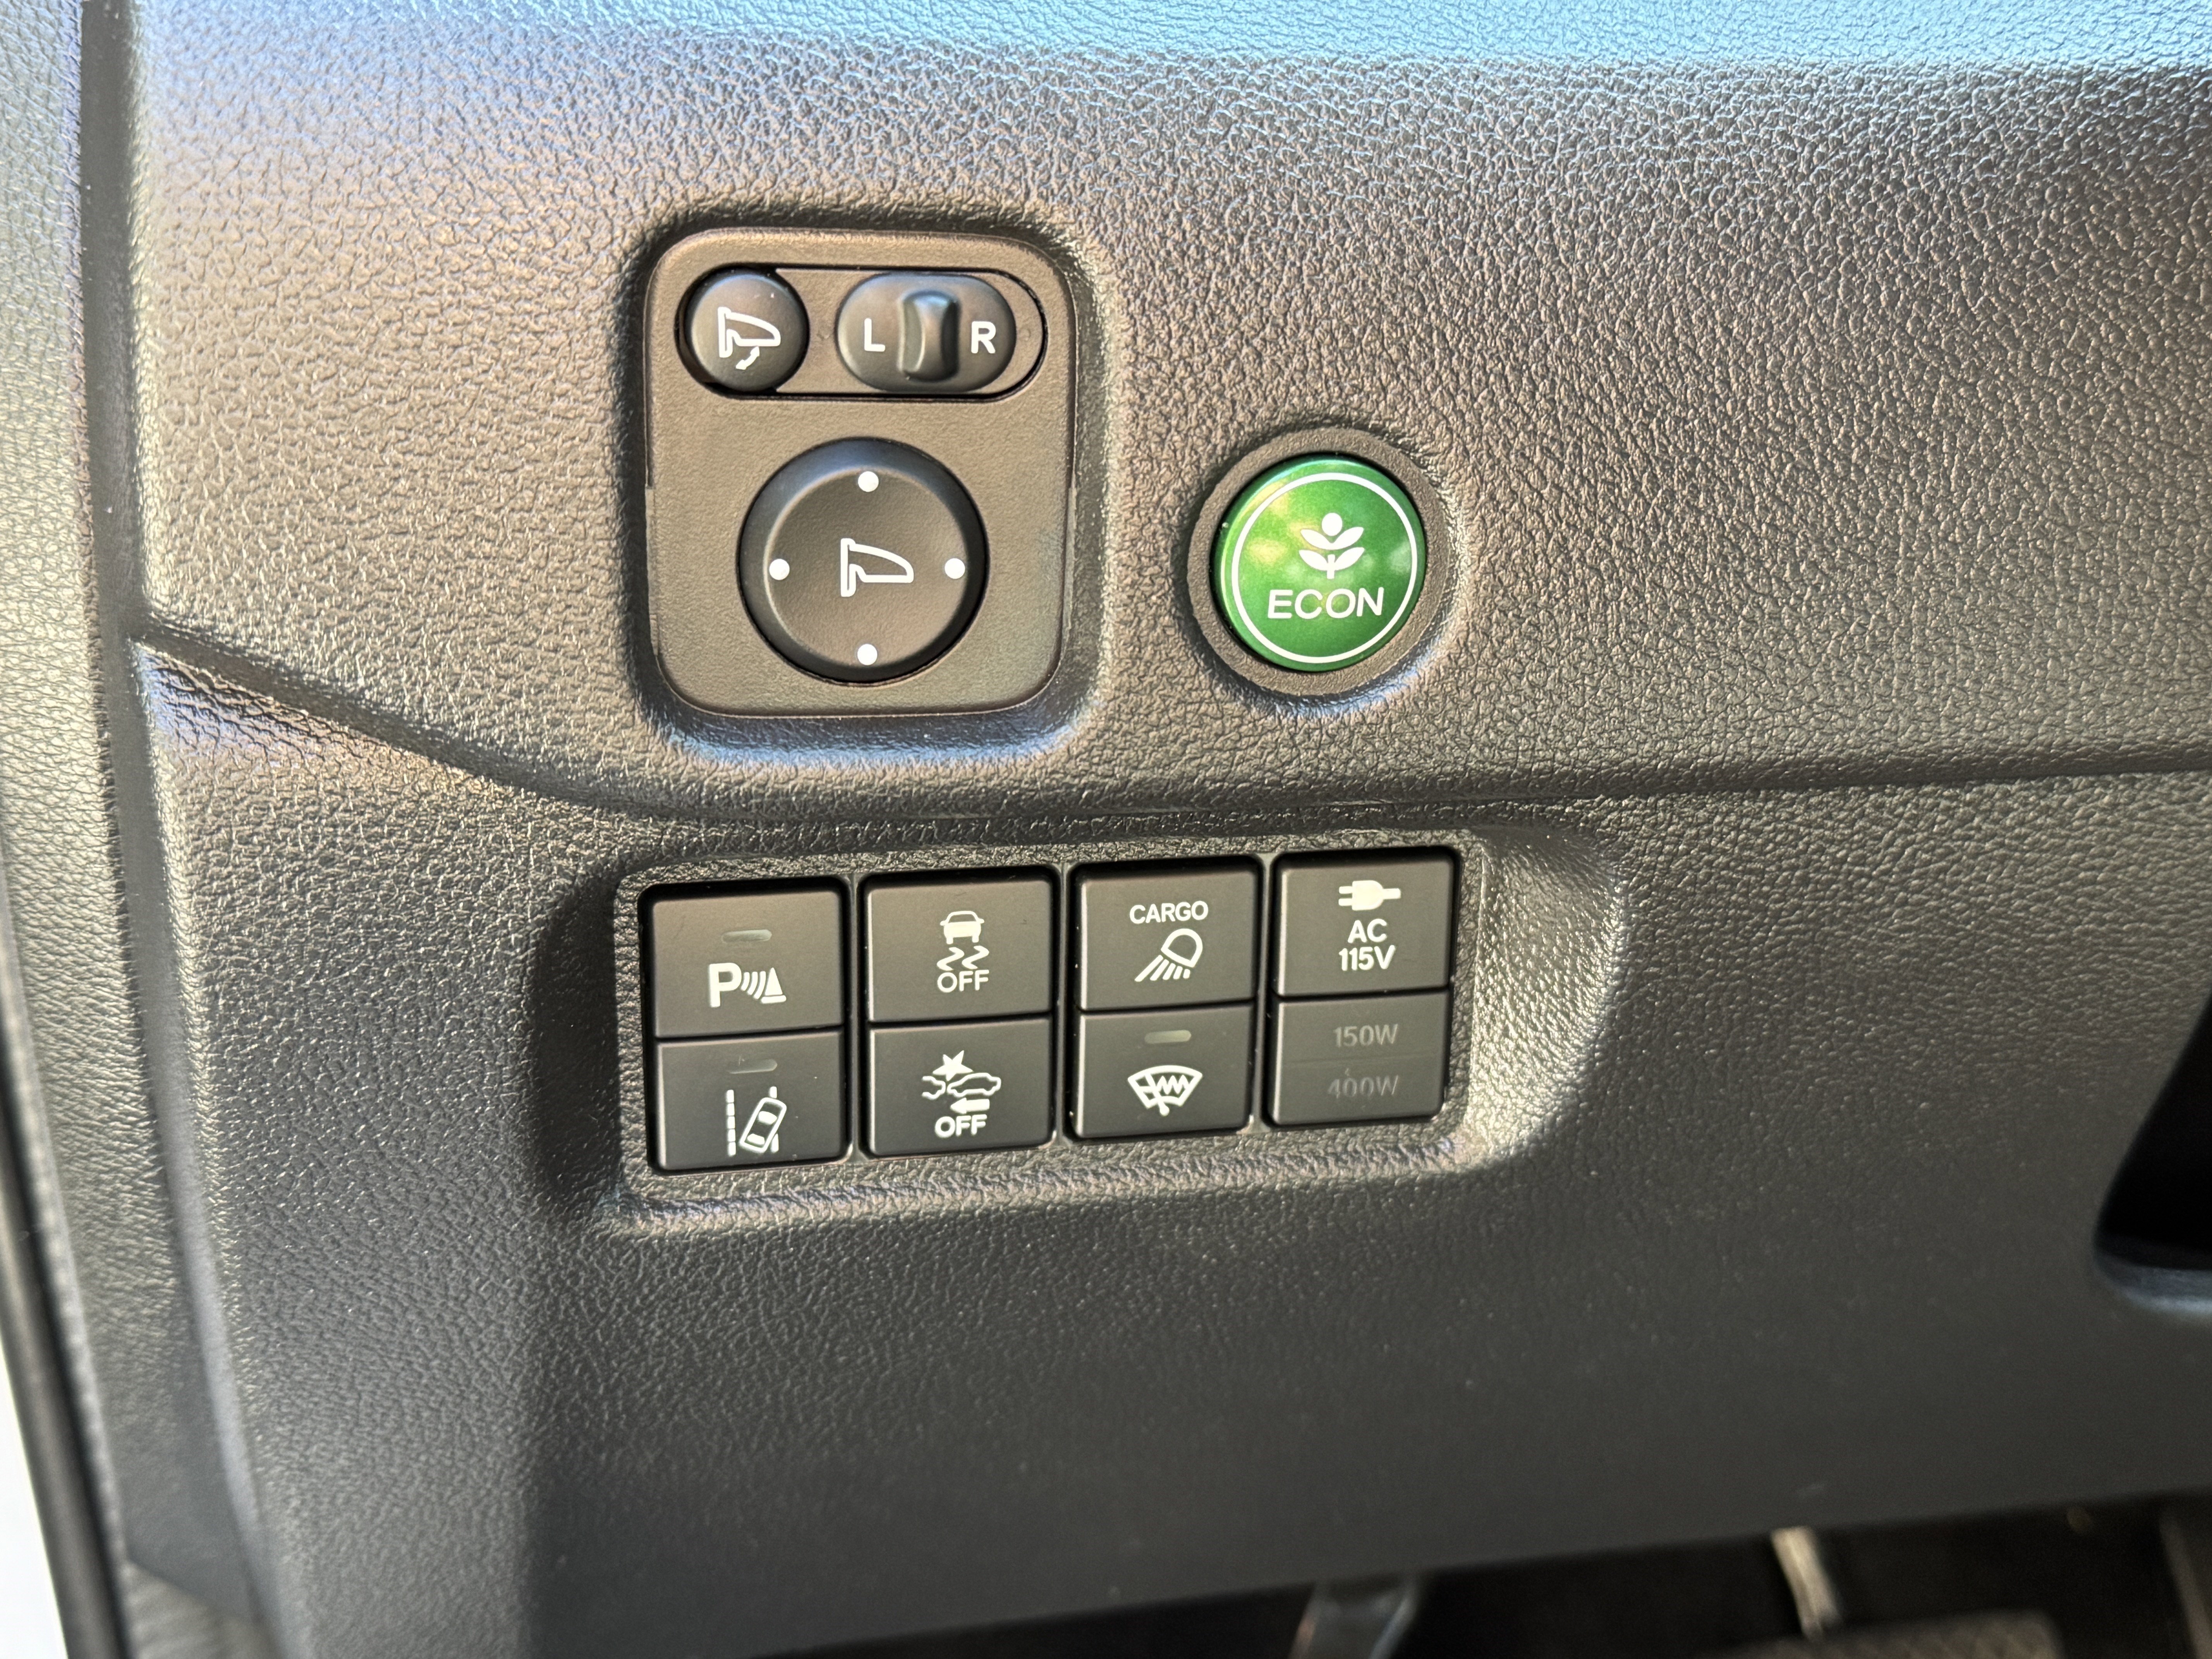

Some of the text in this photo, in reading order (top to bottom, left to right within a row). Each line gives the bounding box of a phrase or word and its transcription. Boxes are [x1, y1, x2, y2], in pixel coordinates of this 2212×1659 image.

[864, 318, 886, 352] L
[971, 321, 996, 354] R
[1267, 587, 1384, 619] ECON
[1129, 900, 1209, 924] CARGO
[1347, 918, 1388, 944] AC
[1338, 945, 1396, 971] 115V
[708, 962, 742, 1008] P
[937, 969, 989, 993] OFF
[1333, 1023, 1398, 1048] 150W
[1327, 1075, 1399, 1099] 400W
[934, 1114, 988, 1138] OFF
